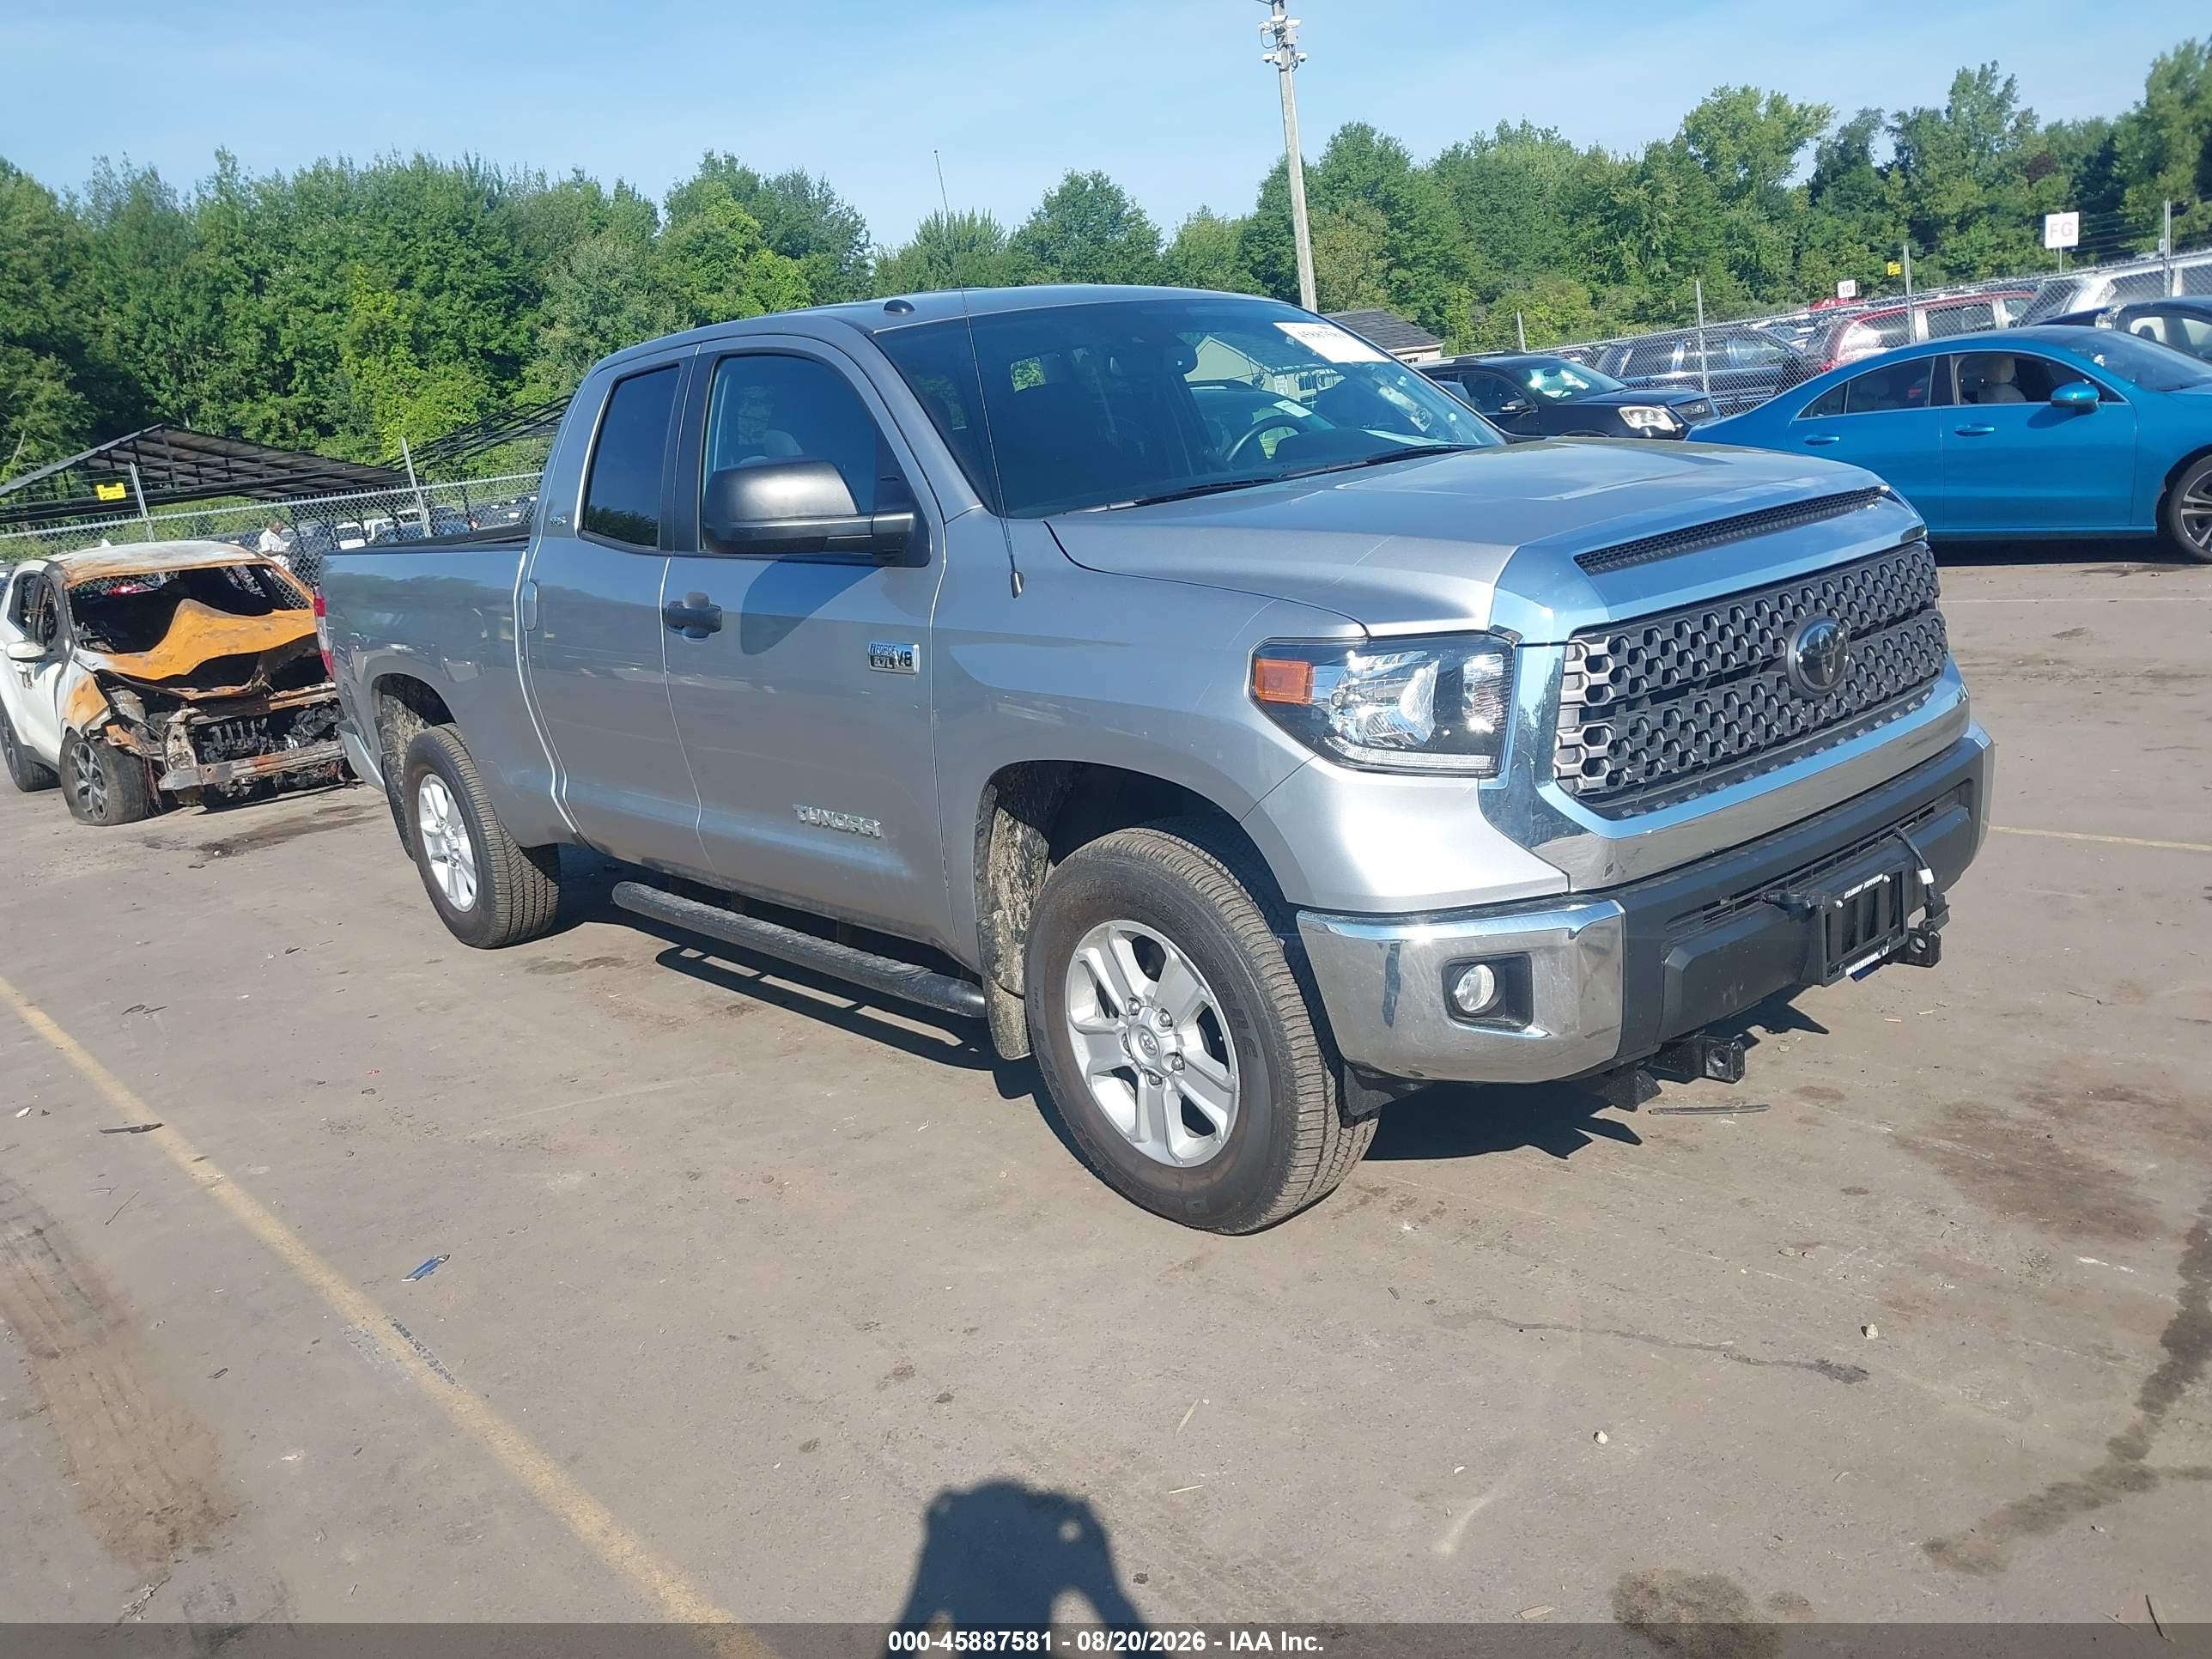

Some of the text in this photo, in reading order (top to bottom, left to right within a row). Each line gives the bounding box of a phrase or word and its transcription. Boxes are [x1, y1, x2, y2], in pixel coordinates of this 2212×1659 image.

[2050, 221, 2074, 239] FG
[1841, 284, 1852, 294] 10
[894, 649, 913, 667] V8
[793, 804, 882, 838] TUNDRA
